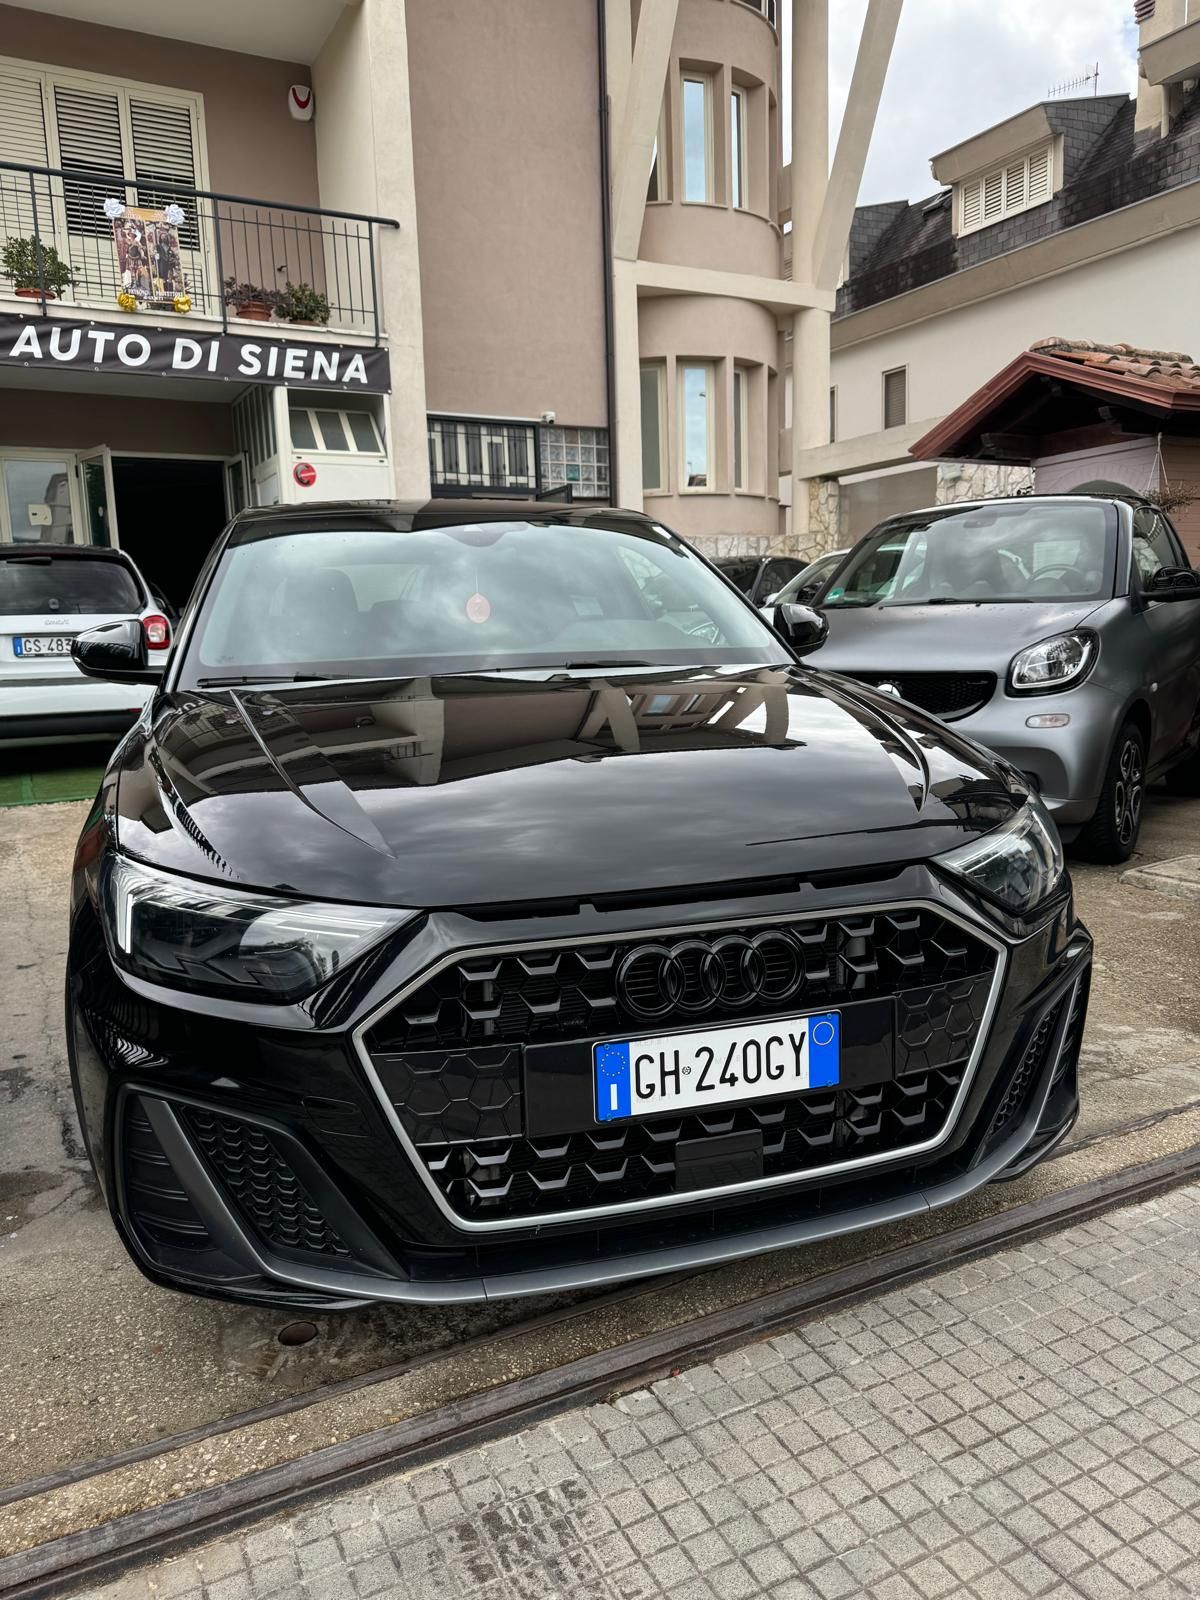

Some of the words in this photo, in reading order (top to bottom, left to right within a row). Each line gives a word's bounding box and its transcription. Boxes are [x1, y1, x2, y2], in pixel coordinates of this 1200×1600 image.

[9, 325, 150, 366] AUTO
[172, 337, 219, 372] DI
[237, 344, 369, 384] SIENA
[634, 1050, 681, 1099] GH
[694, 1031, 807, 1093] 240GY
